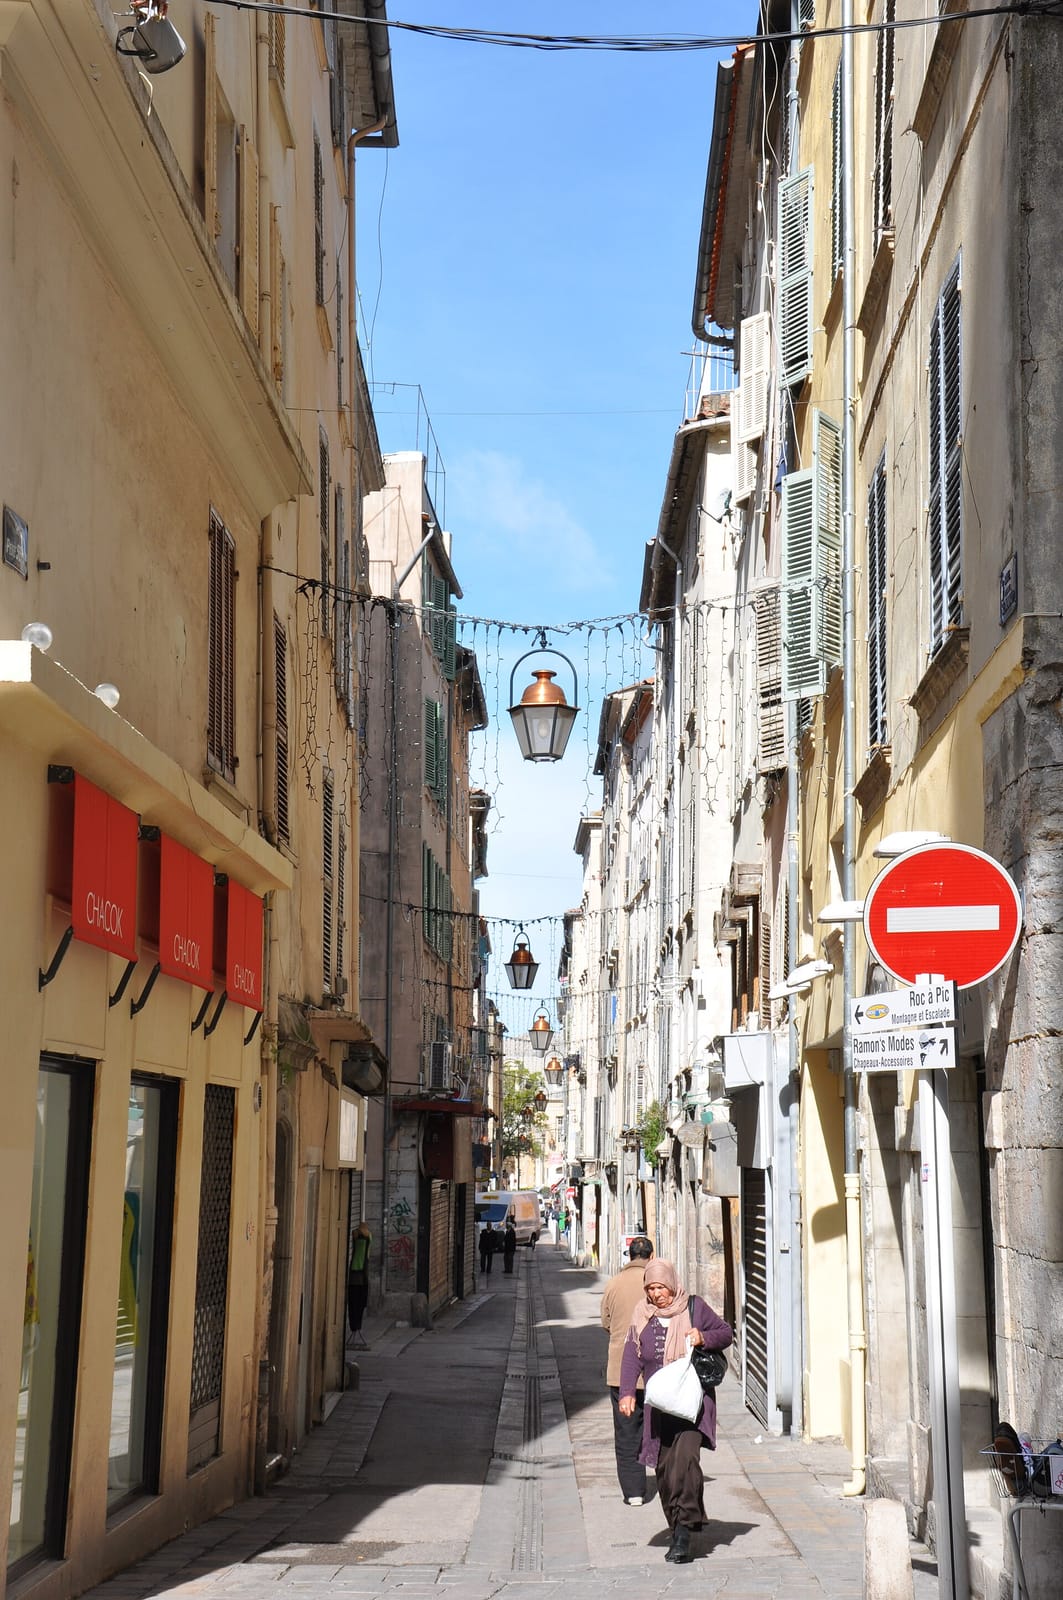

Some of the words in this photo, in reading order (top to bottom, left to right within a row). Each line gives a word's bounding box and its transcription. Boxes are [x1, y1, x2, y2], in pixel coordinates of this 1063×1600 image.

[86, 892, 123, 938] CHACOK
[173, 934, 200, 971] CHACOK
[909, 990, 926, 1008] Roc
[928, 988, 933, 1004] à
[935, 986, 950, 1004] Pic
[891, 1012, 917, 1025] Montagne
[918, 1011, 925, 1021] et
[925, 1008, 950, 1021] Escalade
[853, 1037, 886, 1054] Ramon's
[887, 1035, 915, 1052] Modes
[853, 1056, 914, 1070] Chapeaux-Accessoires
